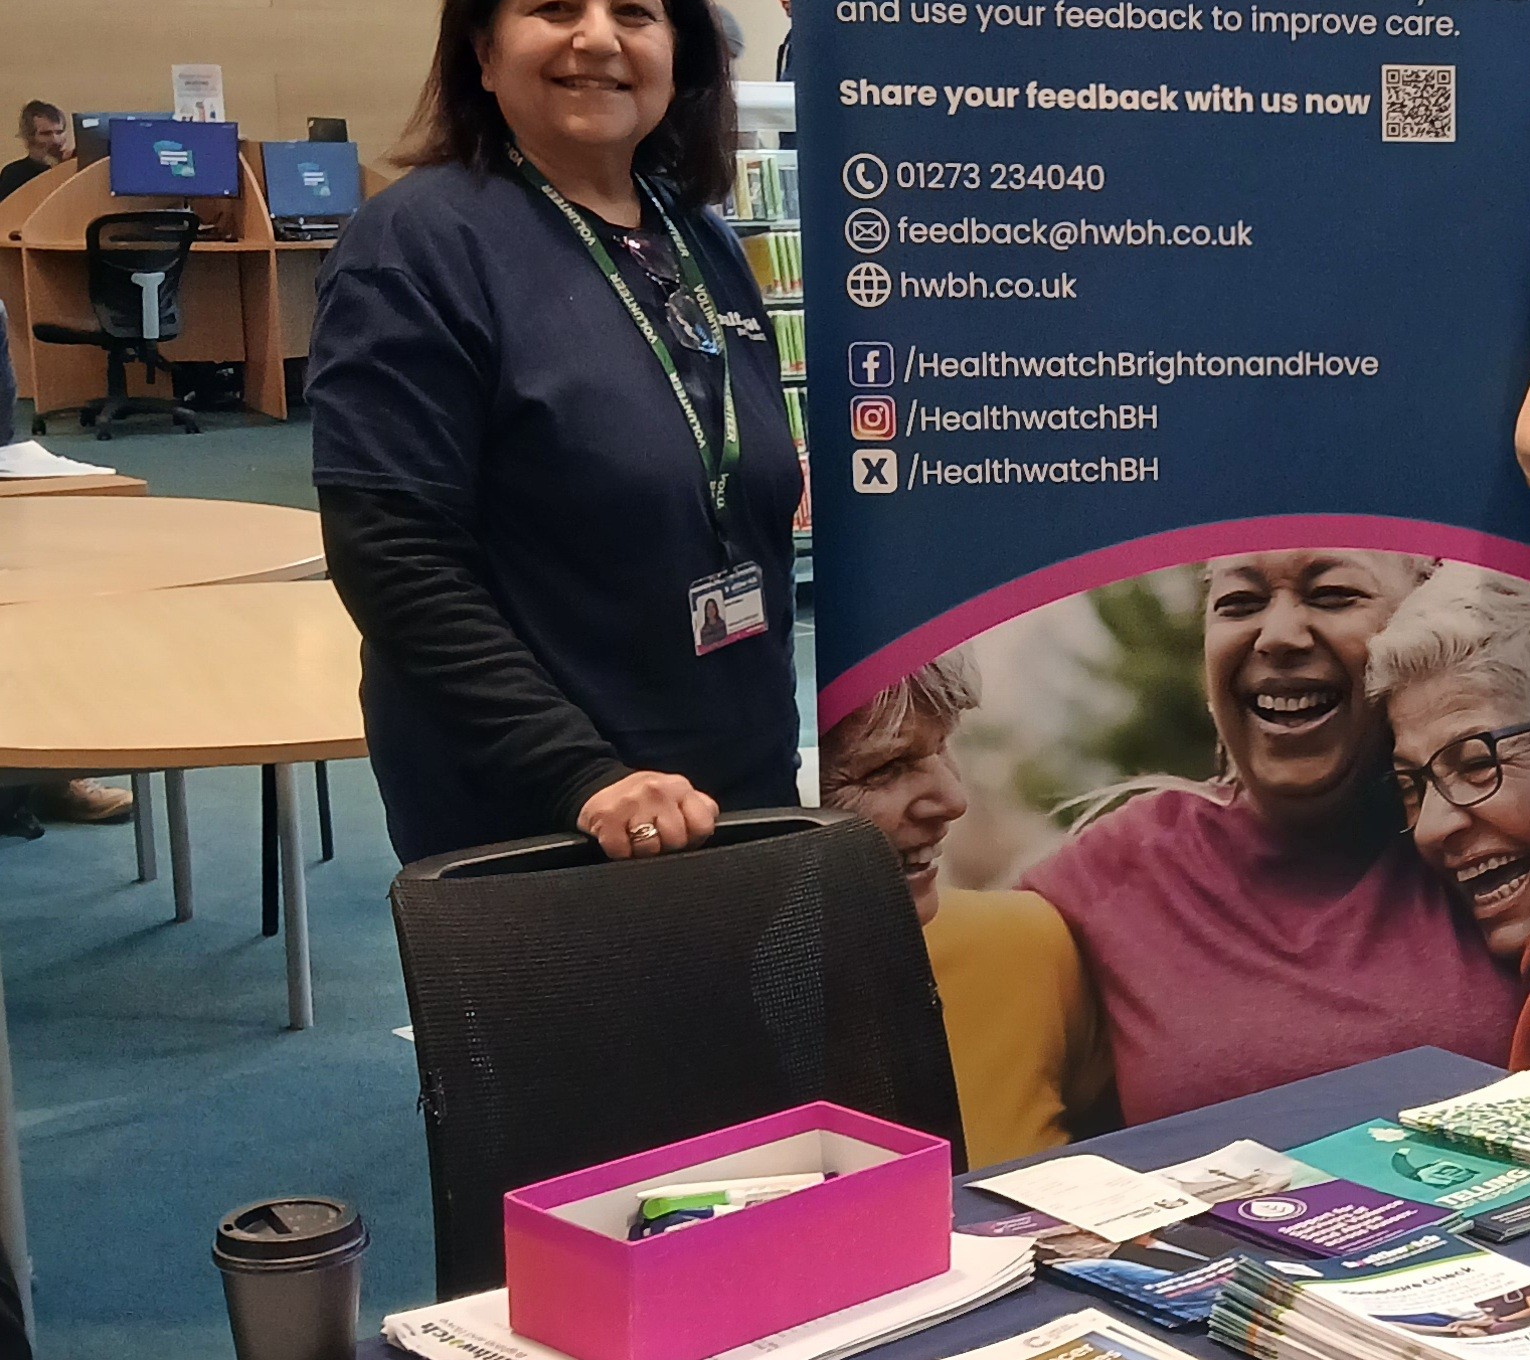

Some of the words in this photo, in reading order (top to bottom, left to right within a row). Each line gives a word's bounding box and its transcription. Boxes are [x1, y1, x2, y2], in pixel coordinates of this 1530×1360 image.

[911, 3, 968, 26] use
[976, 4, 1048, 33] your
[1211, 4, 1242, 31] to
[1250, 6, 1378, 42] improve
[1385, 13, 1461, 38] care.
[839, 78, 938, 109] Share
[945, 84, 1019, 115] your
[1026, 81, 1178, 114] feedback
[1185, 85, 1254, 114] with
[1261, 92, 1299, 115] us
[1304, 92, 1372, 116] now
[896, 161, 980, 190] 01273
[989, 163, 1106, 192] 234040
[541, 184, 596, 247] VOLUNTEER
[898, 215, 1254, 251] feedback@hwbh.co.uk
[900, 271, 1079, 300] hwbh.co.uk
[609, 272, 658, 345] VOLUNTEER
[902, 346, 1380, 384] /HealthwatchBrightonandHove
[668, 371, 707, 450] VOLUNTEER
[905, 400, 1159, 436] /HealthwatchBH
[907, 453, 1160, 490] /HealthwatchBH
[1422, 1265, 1476, 1288] Check
